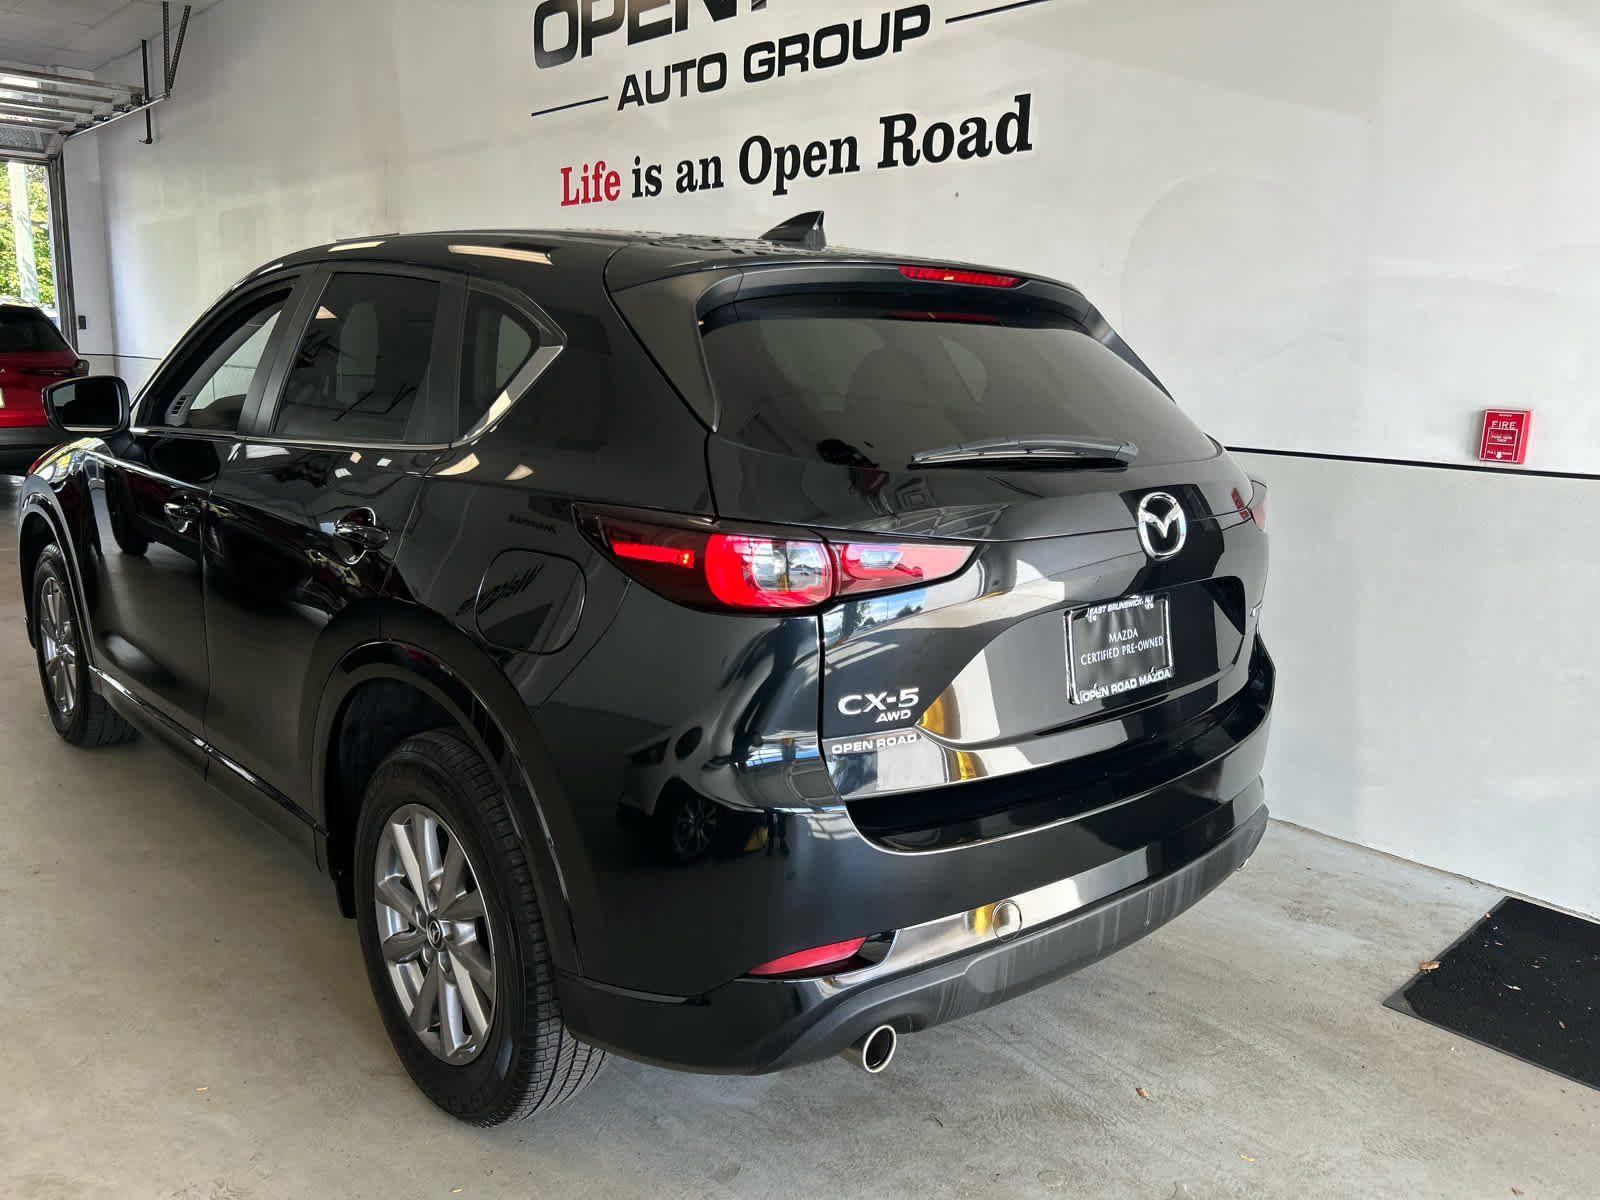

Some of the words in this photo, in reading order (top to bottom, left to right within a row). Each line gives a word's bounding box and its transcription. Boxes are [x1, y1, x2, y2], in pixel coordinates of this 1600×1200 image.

[617, 52, 728, 111] AUTO
[743, 4, 931, 82] GROUP
[560, 160, 621, 206] Life
[631, 156, 663, 198] is
[676, 155, 723, 193] an
[738, 130, 860, 196] Open
[877, 94, 1033, 169] Road
[1491, 420, 1517, 429] FIRE
[1108, 628, 1139, 643] MAZDA
[1080, 647, 1120, 665] CERTIFIED
[1121, 635, 1165, 656] PRE-OWNED
[1081, 685, 1109, 702] OPEN
[1111, 678, 1138, 695] ROAD
[1138, 668, 1171, 687] MAZDA
[838, 687, 920, 715] CX-5
[875, 709, 912, 723] AWD
[831, 740, 874, 755] OPEN
[876, 734, 917, 748] ROAD
